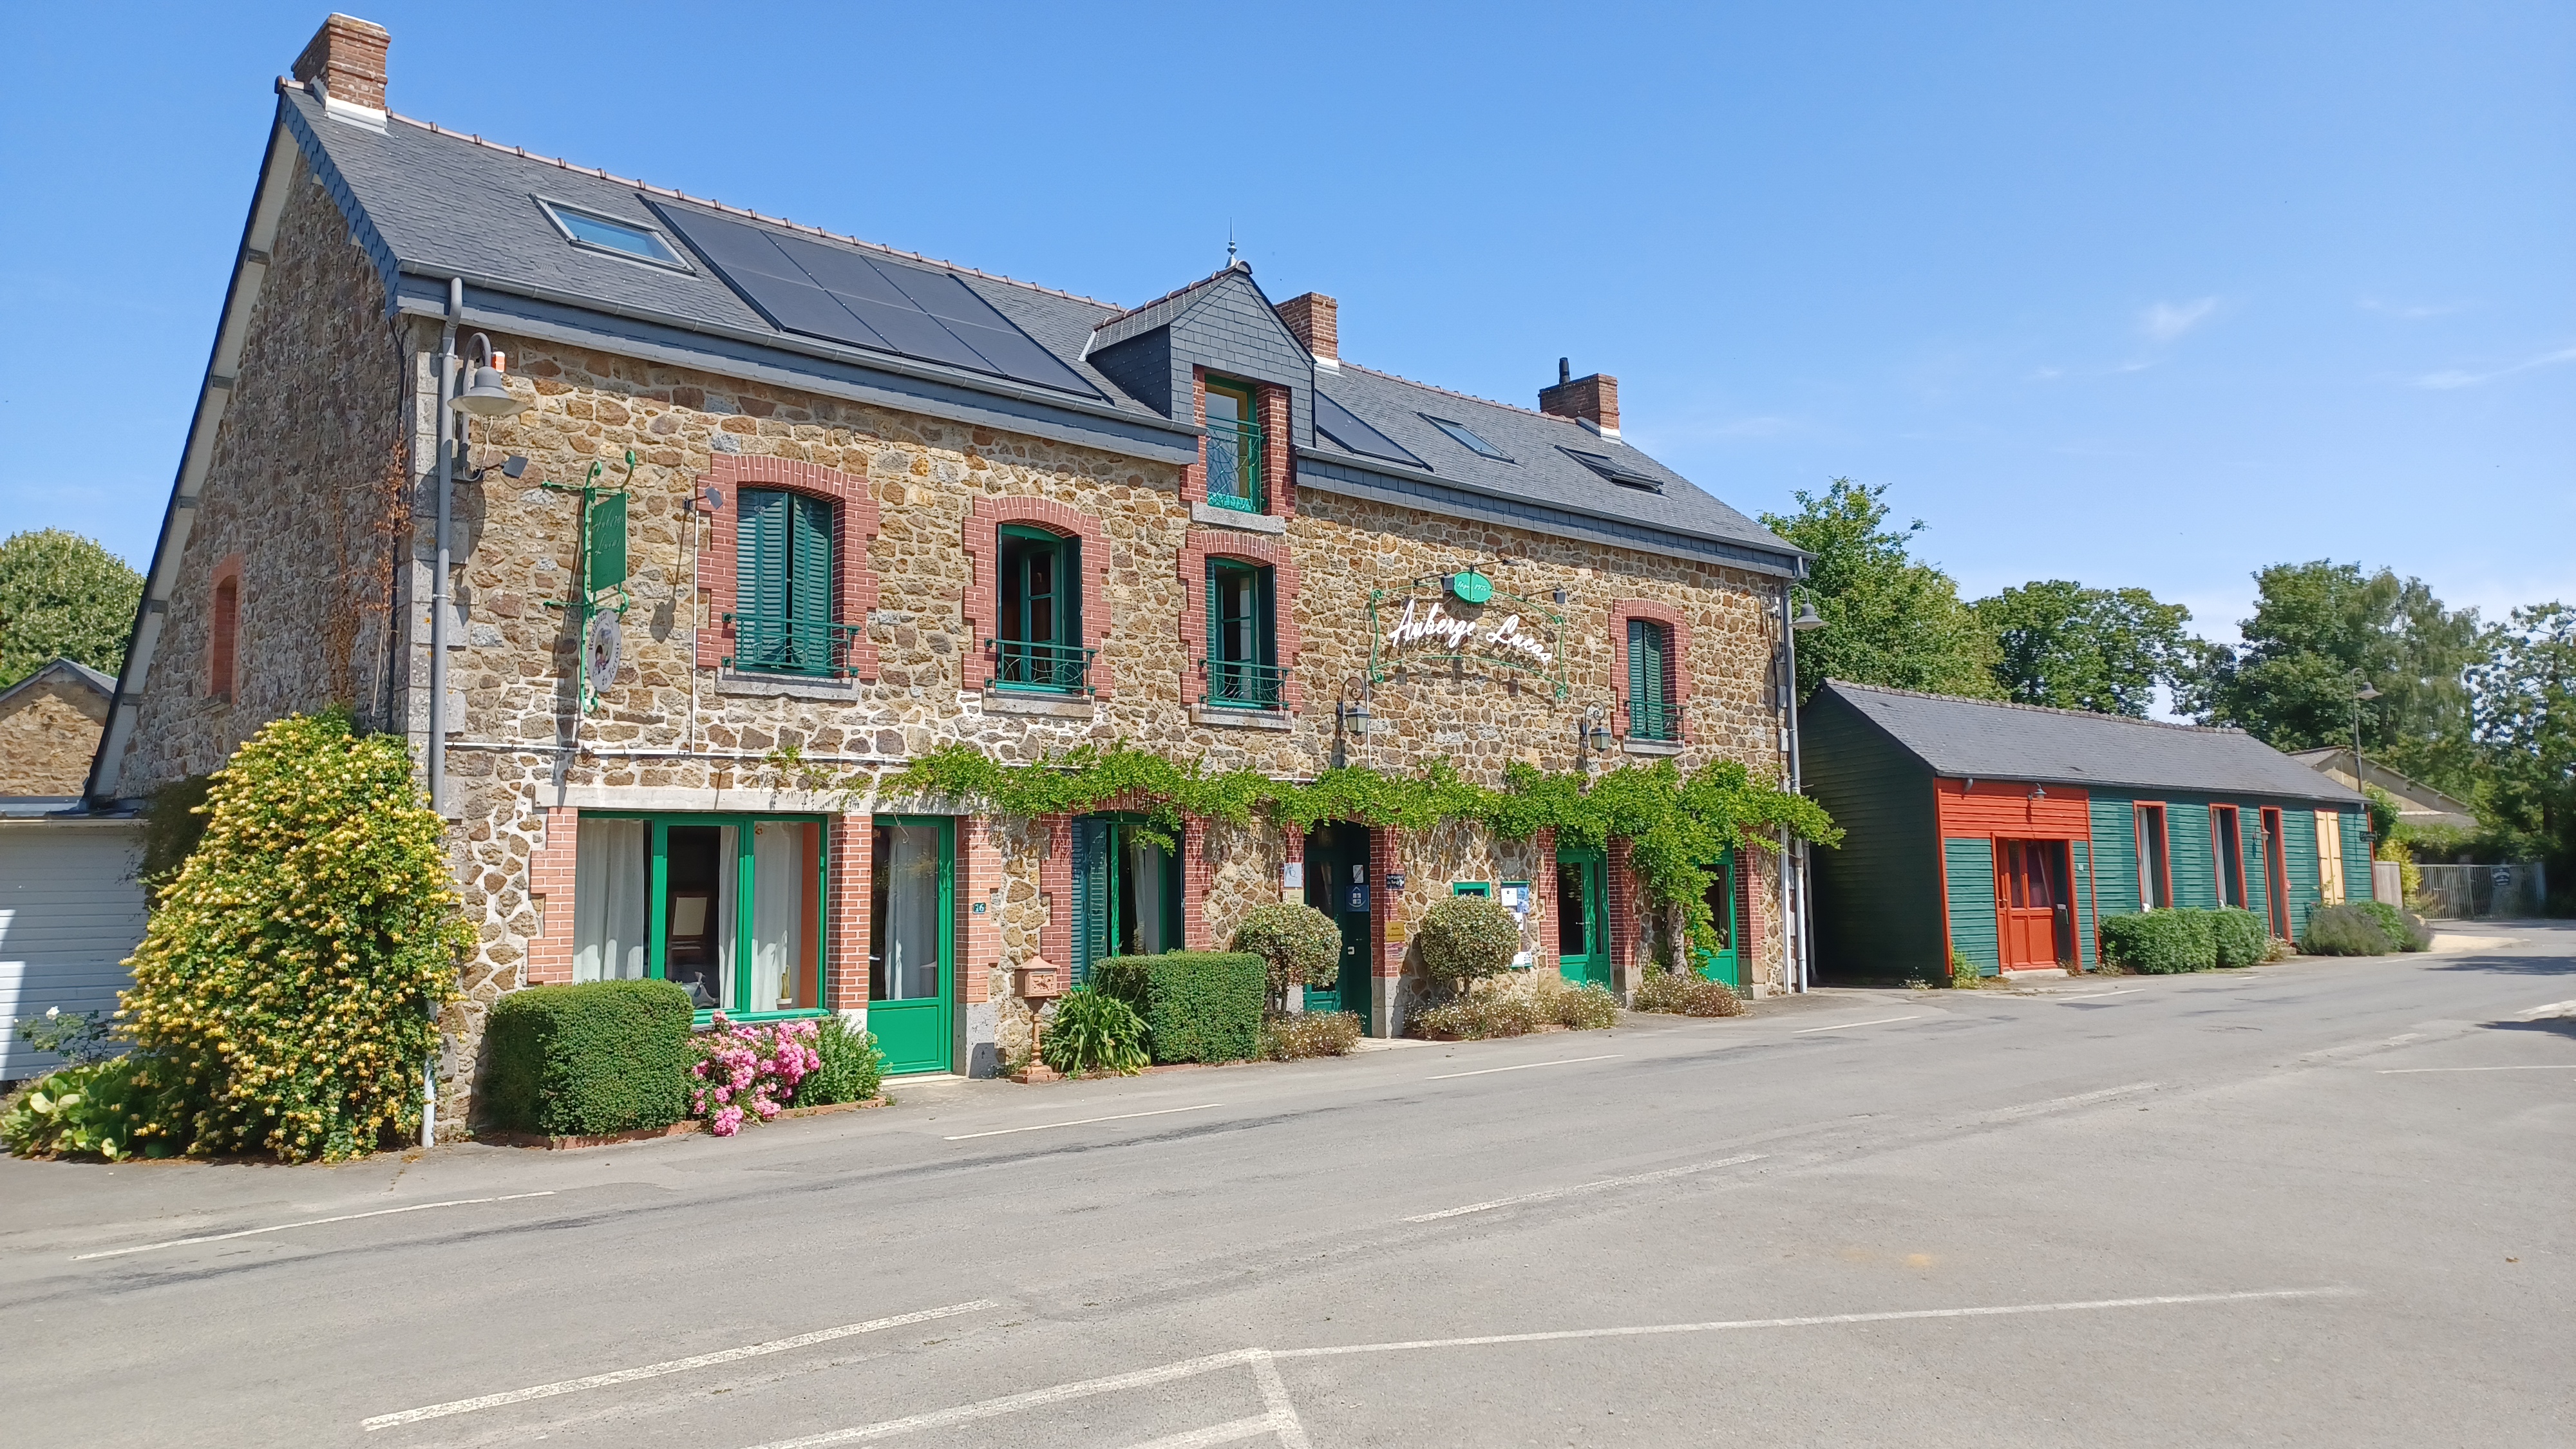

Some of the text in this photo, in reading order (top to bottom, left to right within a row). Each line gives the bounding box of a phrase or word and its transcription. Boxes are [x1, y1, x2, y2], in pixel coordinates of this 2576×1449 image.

[1390, 598, 1553, 663] Auberge Lucas
[608, 642, 619, 678] Terroir
[975, 904, 984, 912] 16
